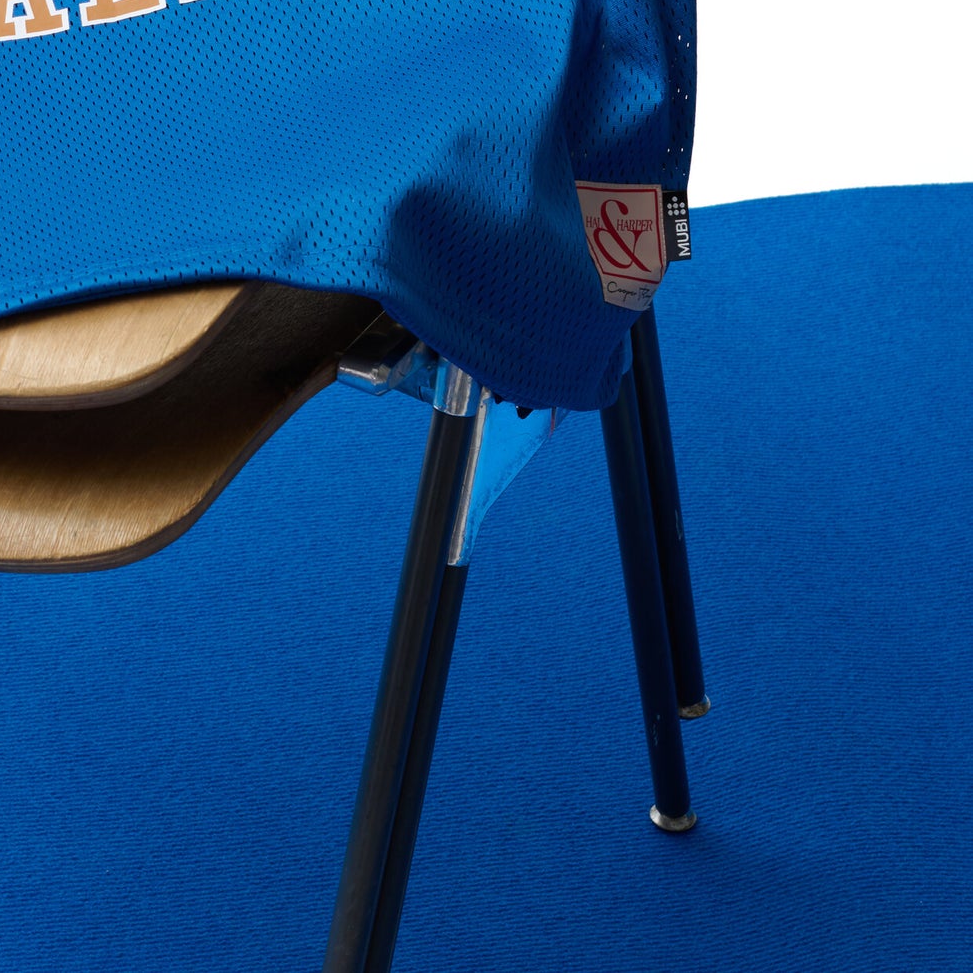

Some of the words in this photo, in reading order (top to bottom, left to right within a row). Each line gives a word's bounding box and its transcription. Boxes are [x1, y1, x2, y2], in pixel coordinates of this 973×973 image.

[593, 199, 652, 272] &
[616, 219, 653, 231] HARPER
[675, 218, 691, 257] MUBI
